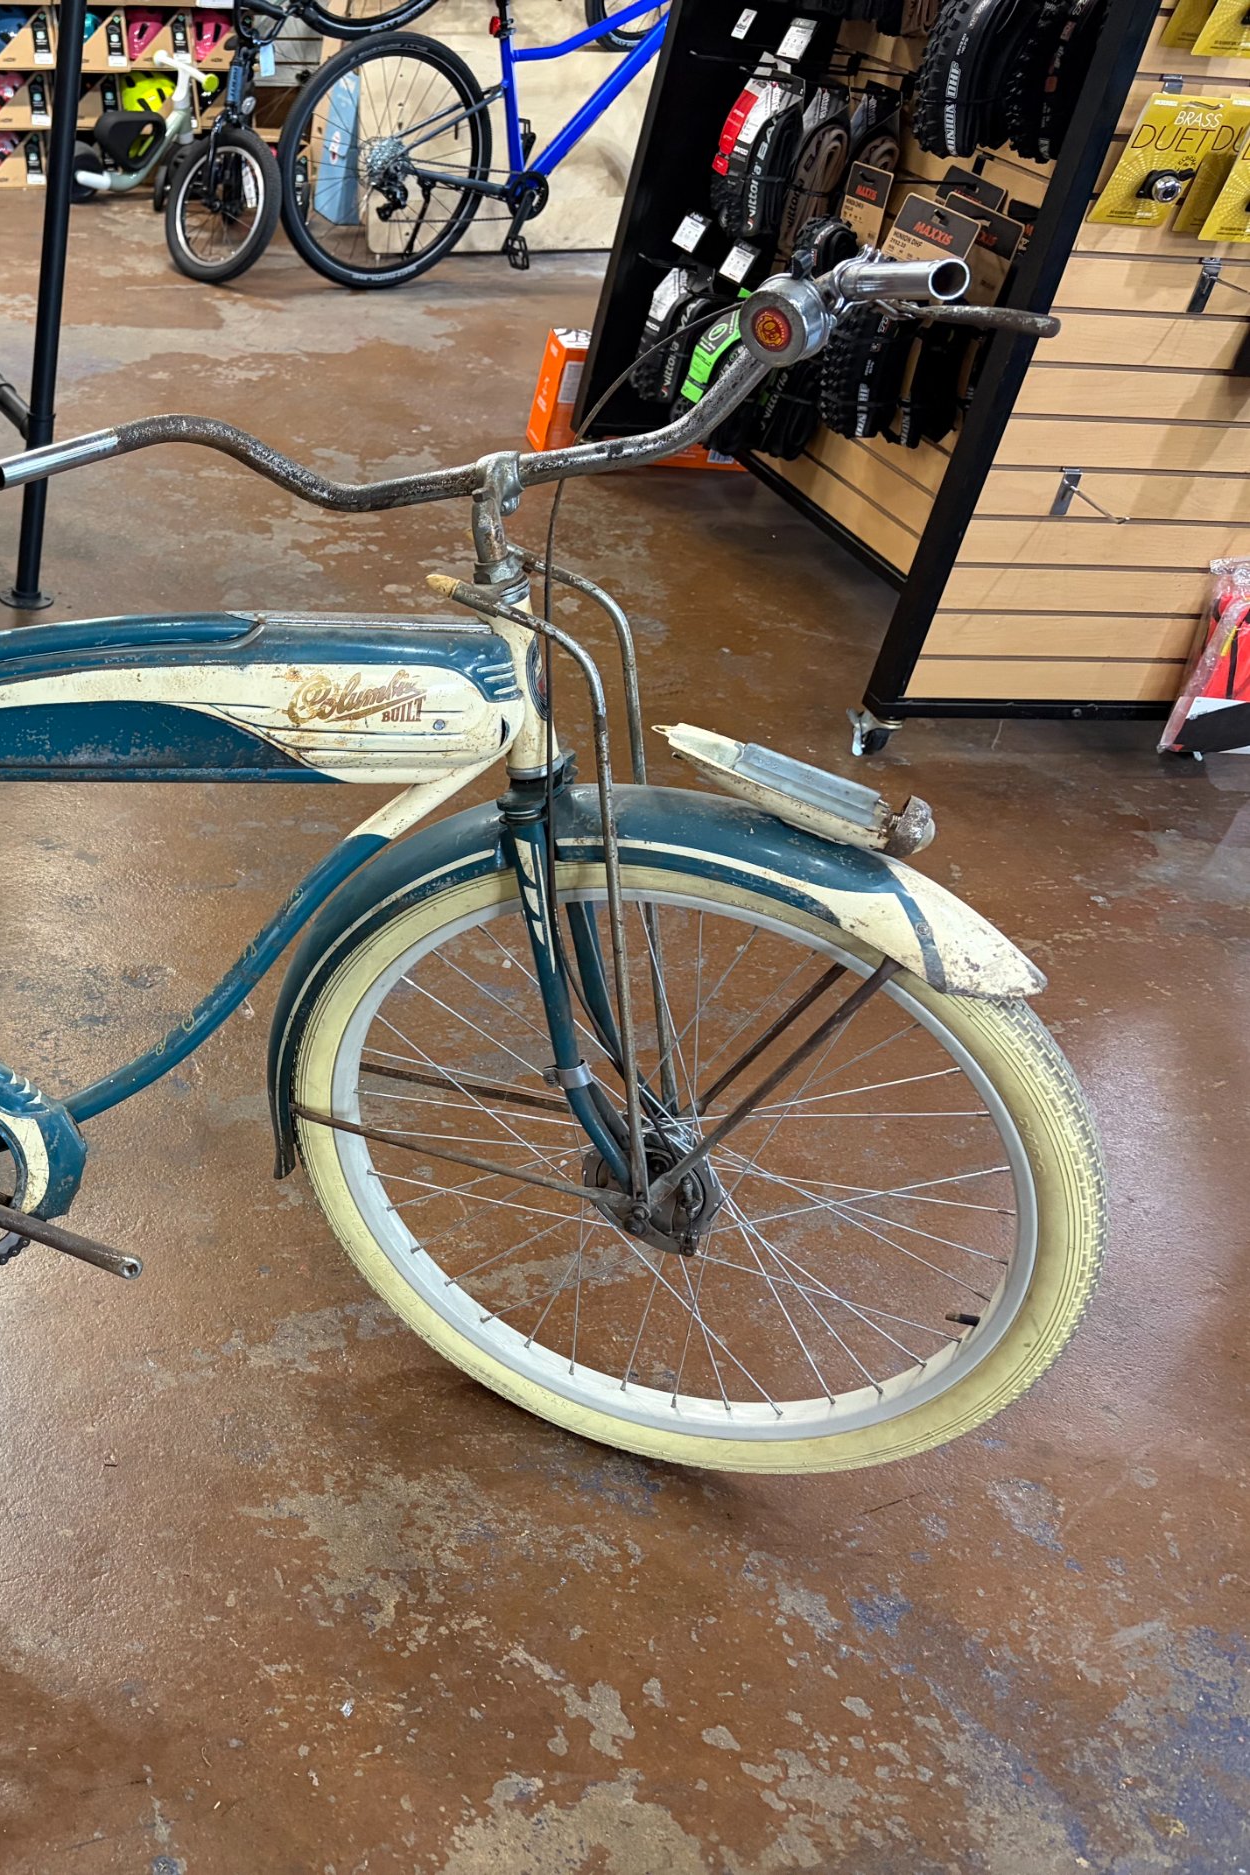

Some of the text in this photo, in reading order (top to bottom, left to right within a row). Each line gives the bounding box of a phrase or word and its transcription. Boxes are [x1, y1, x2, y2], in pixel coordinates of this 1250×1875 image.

[1173, 110, 1223, 128] BRASS
[1131, 124, 1216, 154] DUET
[912, 221, 954, 246] MAXXIS
[287, 669, 429, 724] Columbia
[382, 697, 426, 723] BUILT
